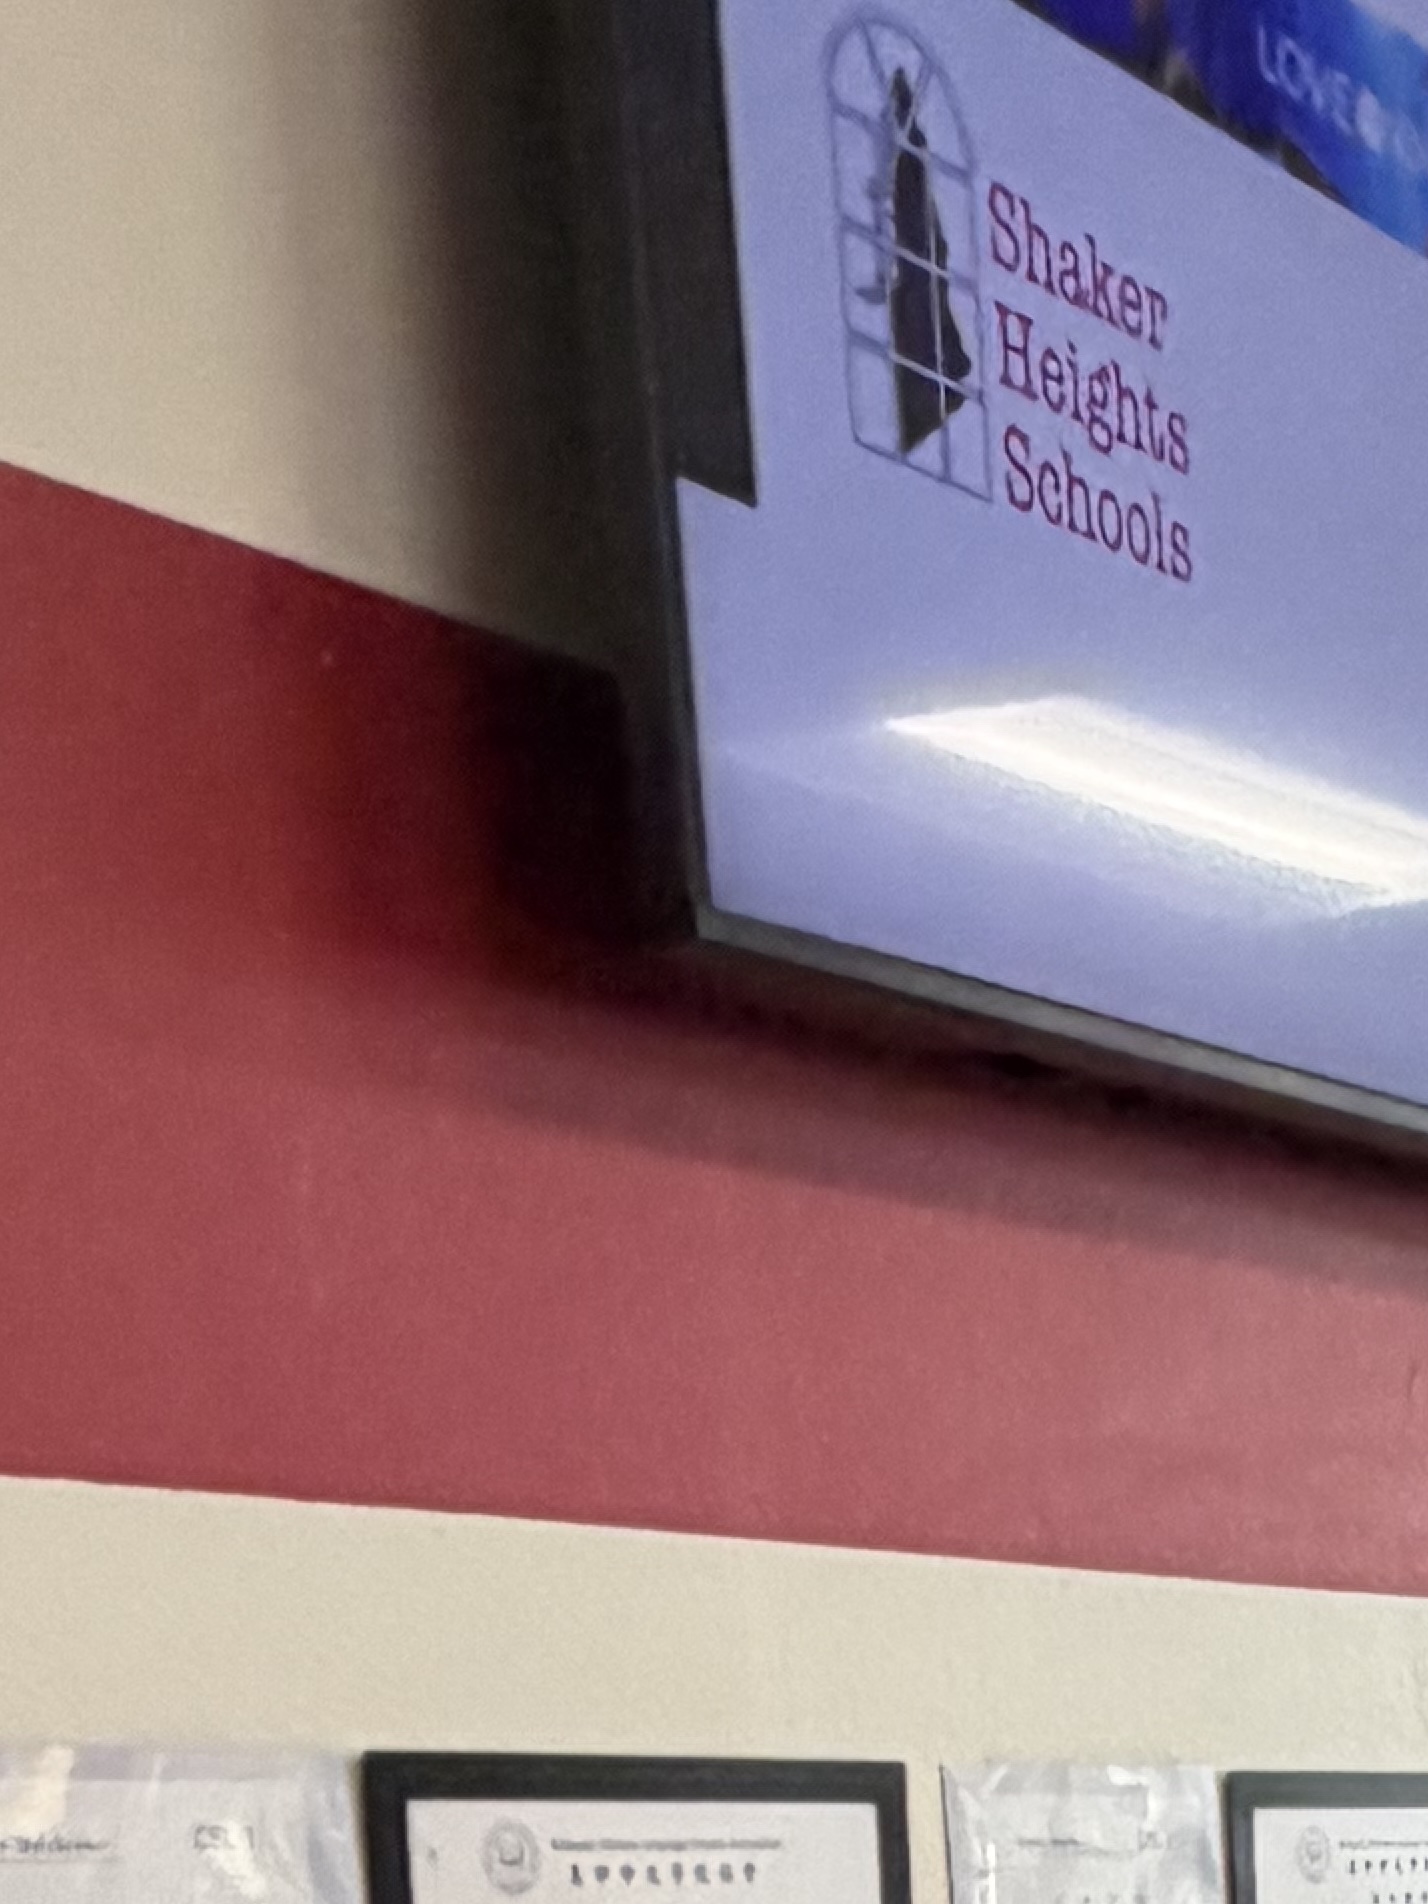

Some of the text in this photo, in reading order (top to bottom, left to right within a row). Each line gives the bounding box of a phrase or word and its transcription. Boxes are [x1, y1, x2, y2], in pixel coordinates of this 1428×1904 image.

[987, 182, 1168, 351] Shaker
[994, 300, 1190, 475] Heights
[1003, 423, 1192, 582] Schools
